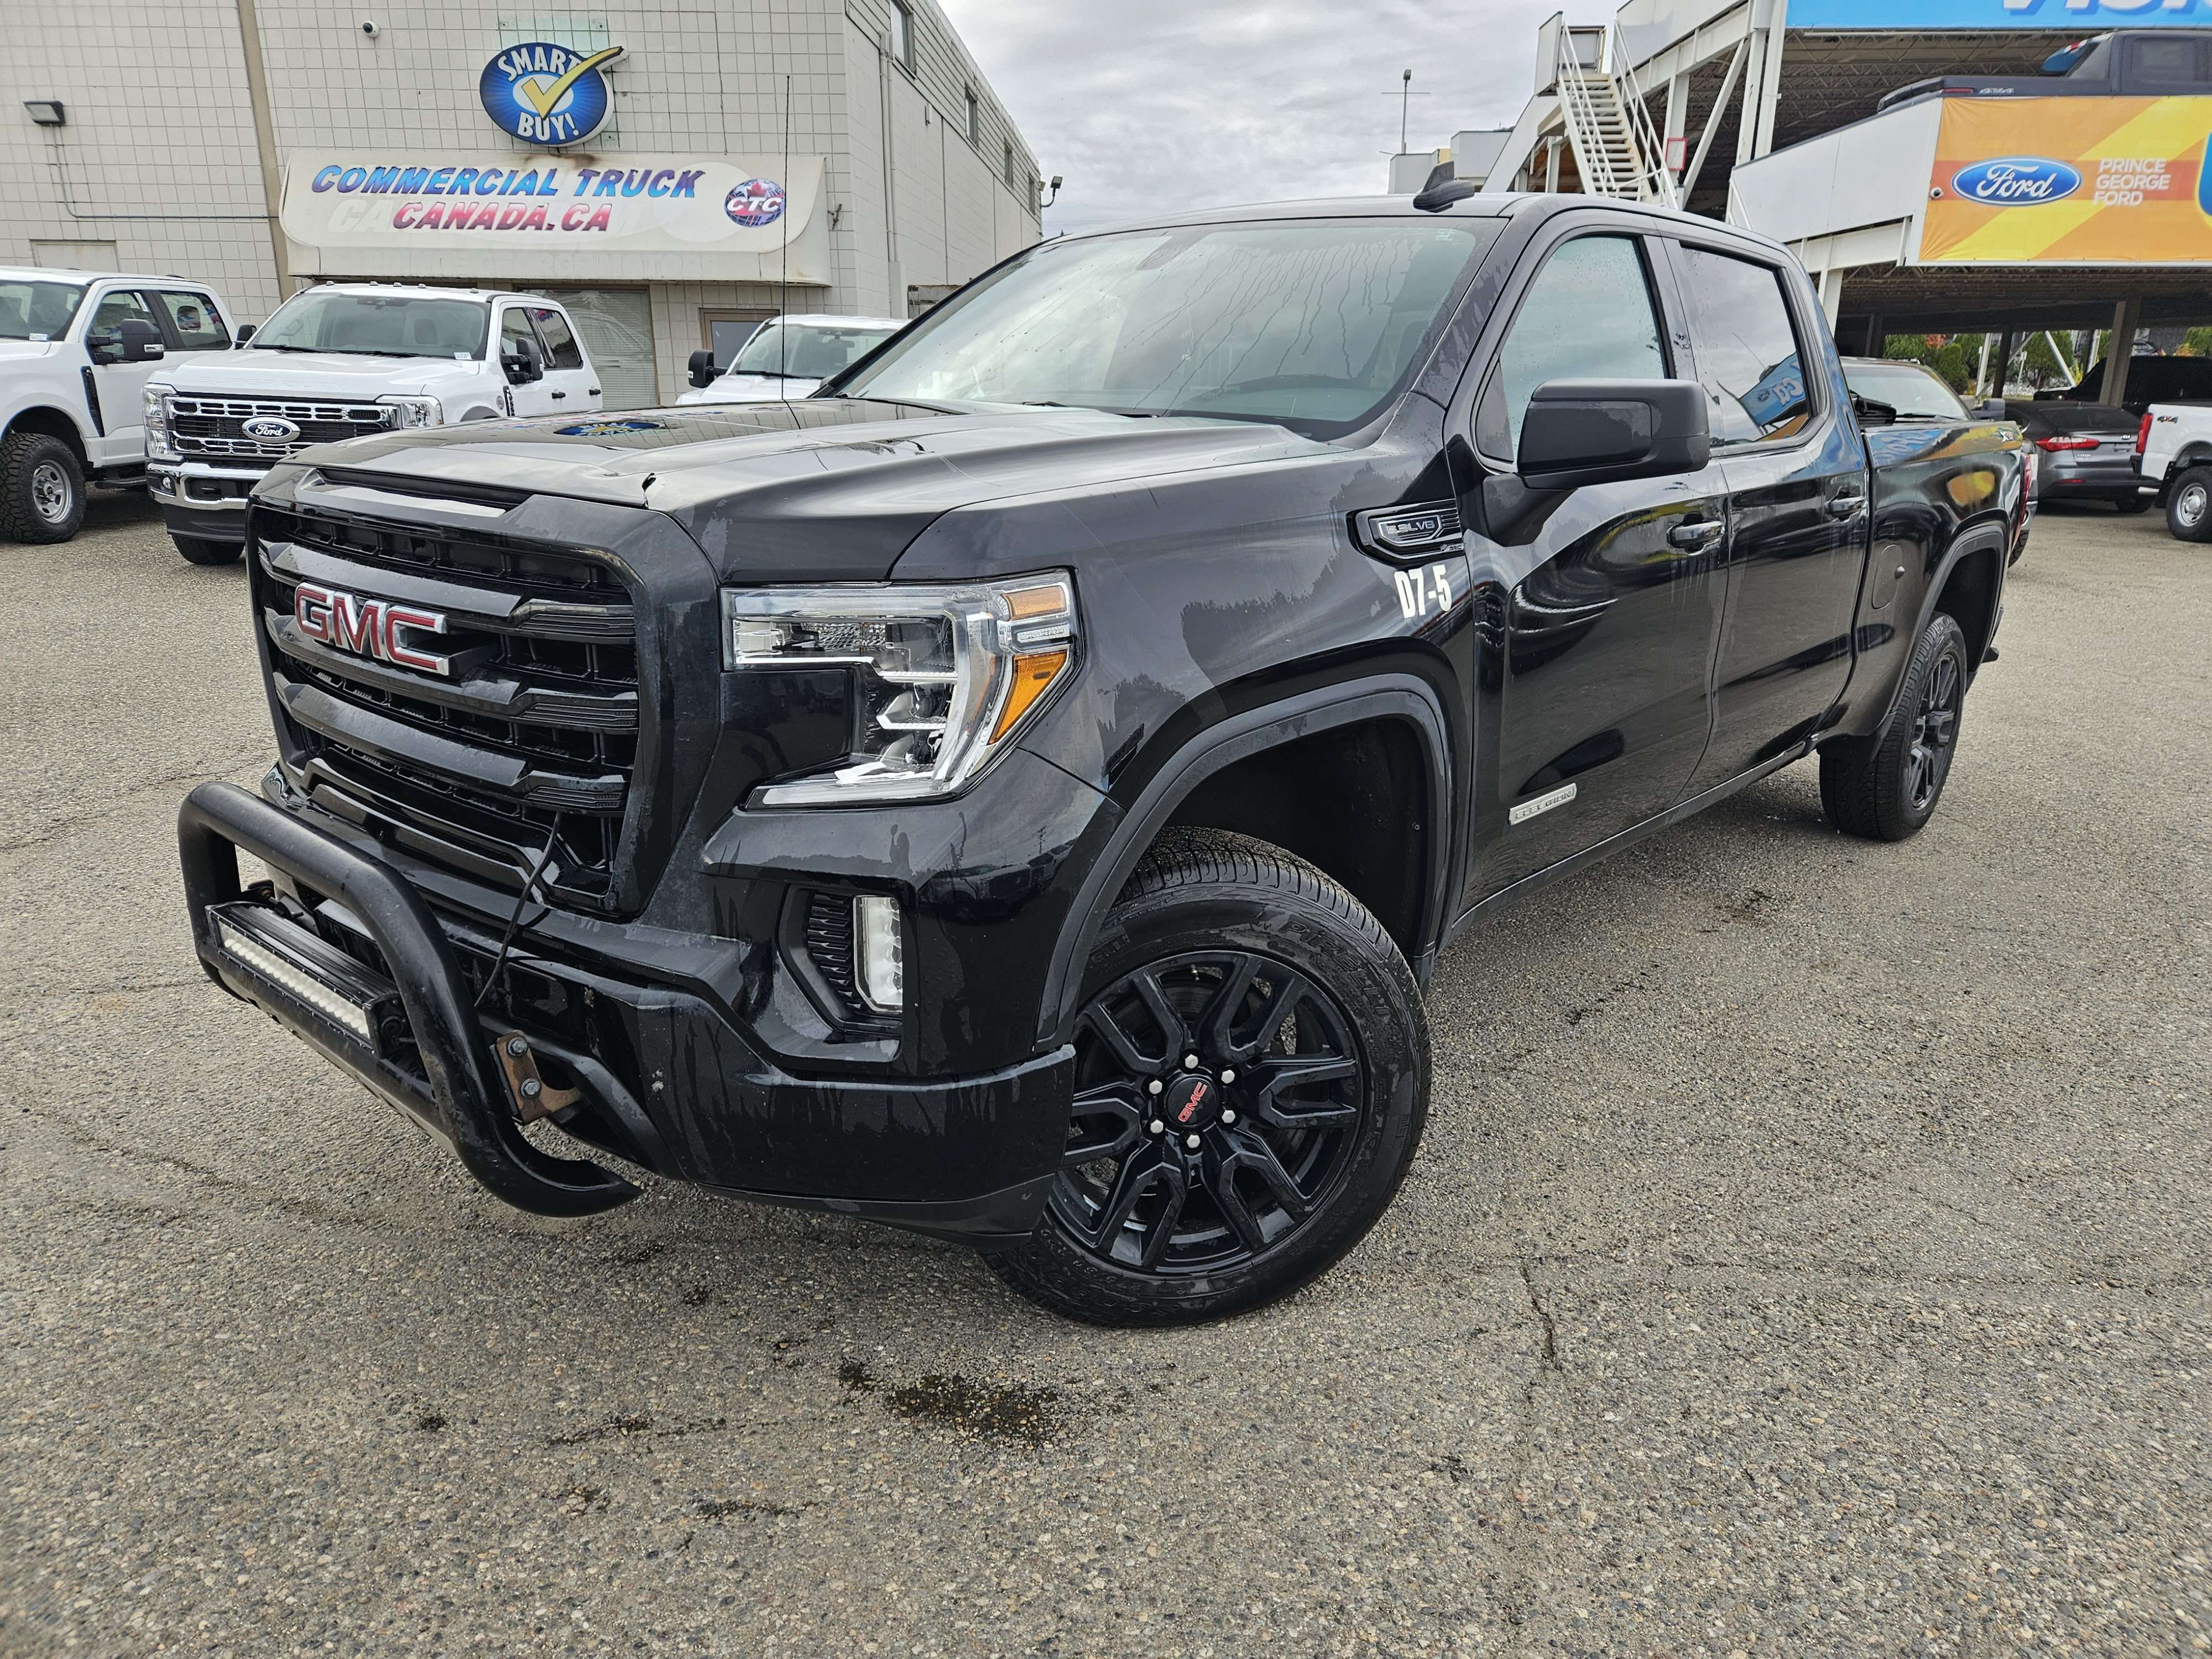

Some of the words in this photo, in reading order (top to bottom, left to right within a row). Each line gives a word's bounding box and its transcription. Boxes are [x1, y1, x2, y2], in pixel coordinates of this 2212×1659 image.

[498, 46, 582, 82] SMART
[518, 112, 580, 141] BUY!
[2099, 158, 2167, 173] PRINCE
[311, 165, 557, 196] COMMERCIAL
[573, 169, 706, 198] TRUCK
[1976, 165, 2058, 199] Ford
[2096, 174, 2171, 190] GEORGE
[727, 196, 782, 212] CTC
[2092, 190, 2143, 206] FORD
[393, 202, 612, 232] CANADA.CA
[255, 424, 283, 437] Ford
[295, 582, 450, 676] GMC
[1177, 1081, 1208, 1123] GMC
